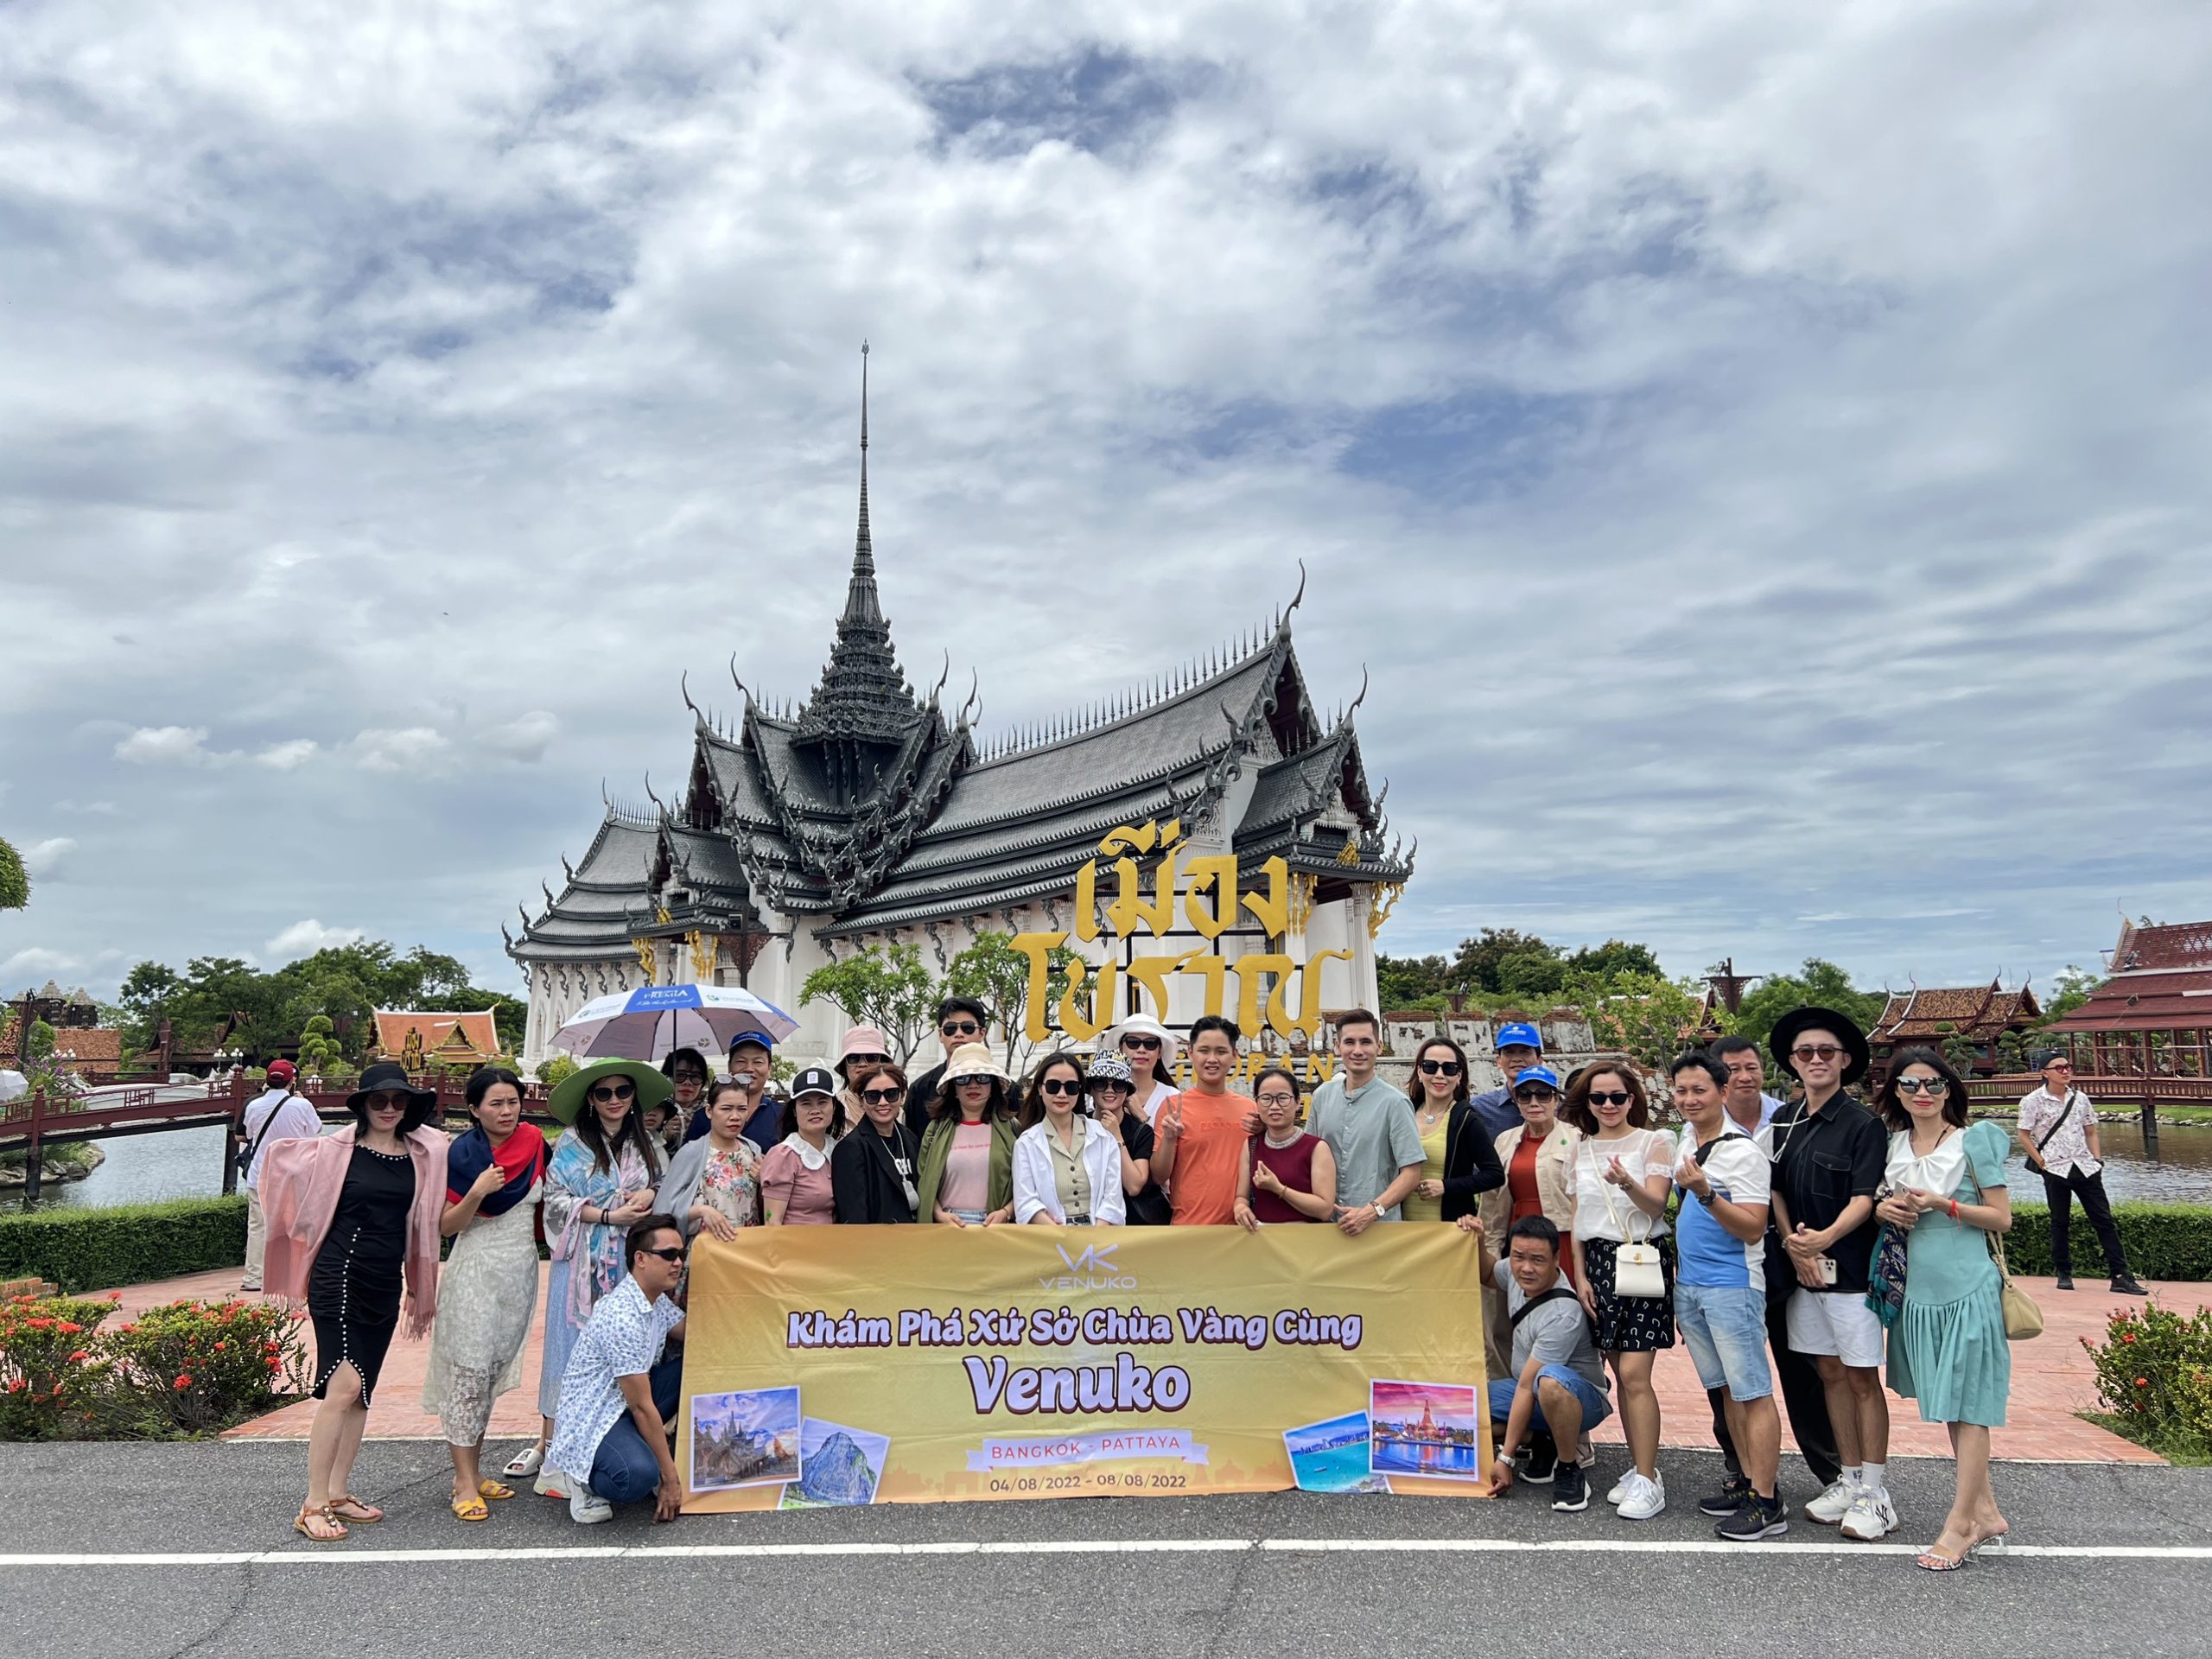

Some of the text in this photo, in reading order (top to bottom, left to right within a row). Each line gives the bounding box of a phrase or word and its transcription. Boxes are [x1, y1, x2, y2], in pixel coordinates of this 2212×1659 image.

[1076, 817, 1288, 943] เมือง
[1056, 1243, 1119, 1272] VK
[1039, 1276, 1137, 1290] VENUKO
[787, 1306, 1363, 1351] Khám Phá Xứ Sở Chùa Vàng Cùng
[962, 1351, 1191, 1414] Venuko
[991, 1442, 1081, 1459] BANGKOK
[1102, 1436, 1180, 1451] PATTAYA
[989, 1475, 1081, 1494] 04/08/2022
[1097, 1472, 1186, 1490] 08/08/2022
